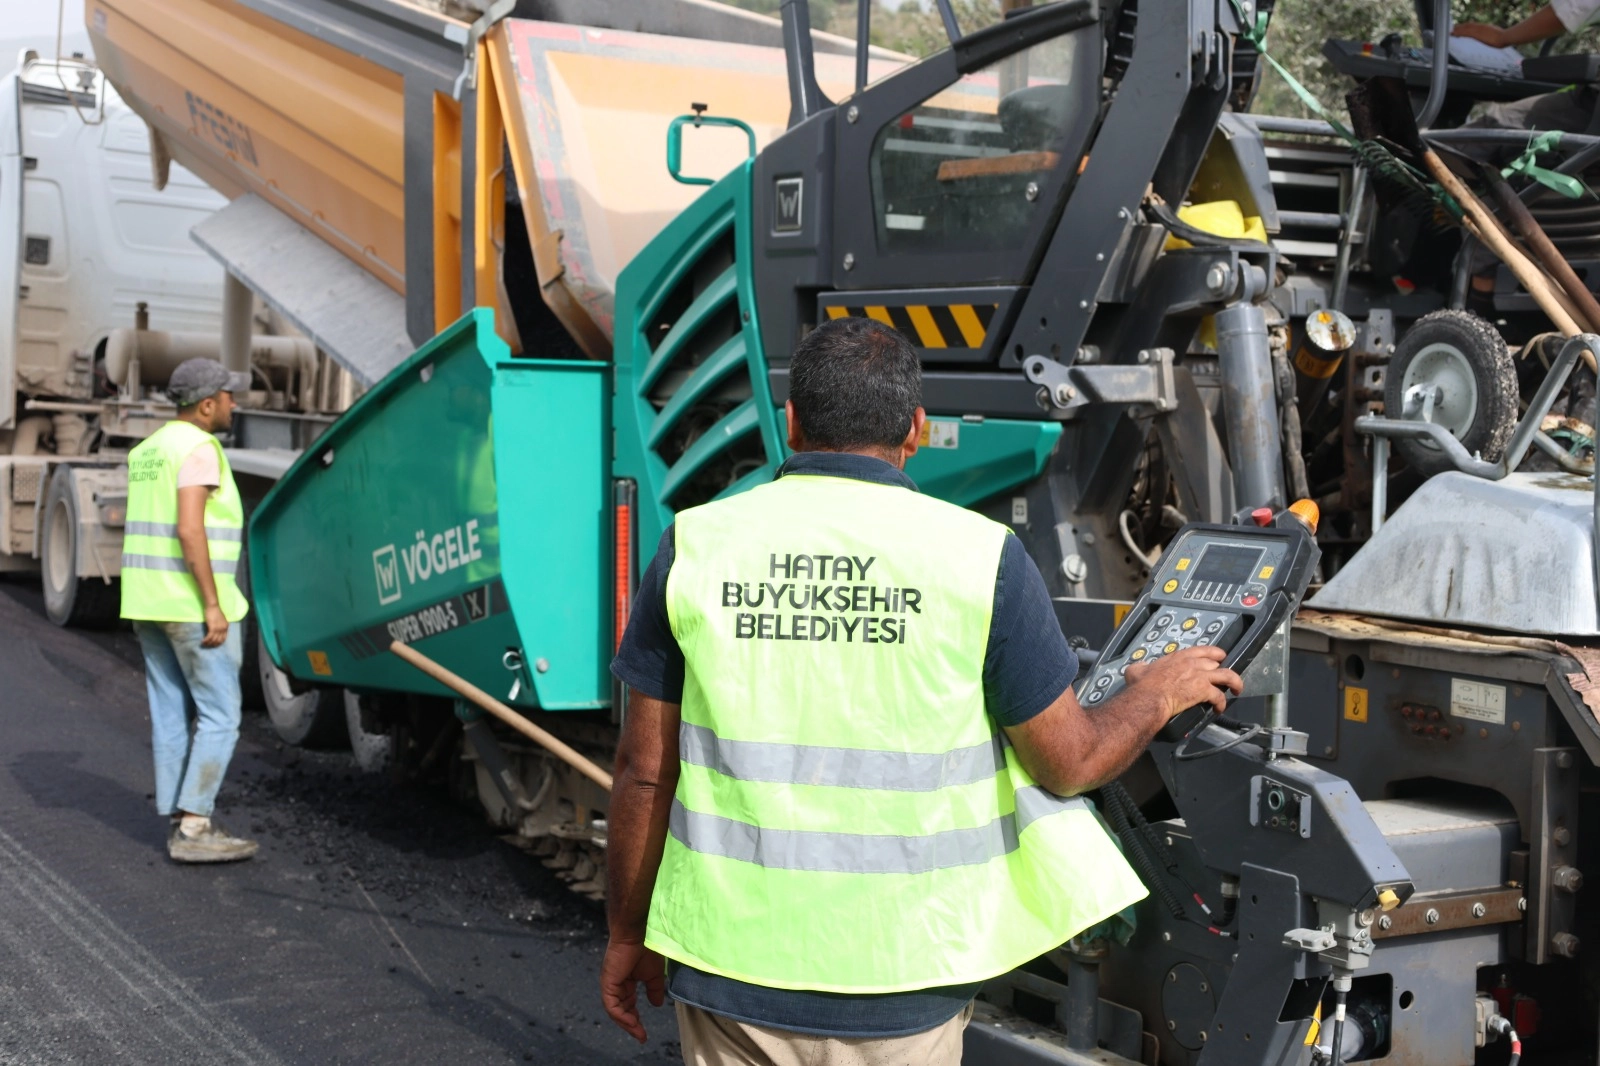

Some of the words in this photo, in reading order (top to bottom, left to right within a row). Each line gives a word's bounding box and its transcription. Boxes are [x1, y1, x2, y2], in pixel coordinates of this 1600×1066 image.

[401, 519, 482, 584] VÖGELE
[769, 553, 876, 581] HATAY
[387, 615, 423, 643] SUPER
[418, 601, 458, 636] 1900-5
